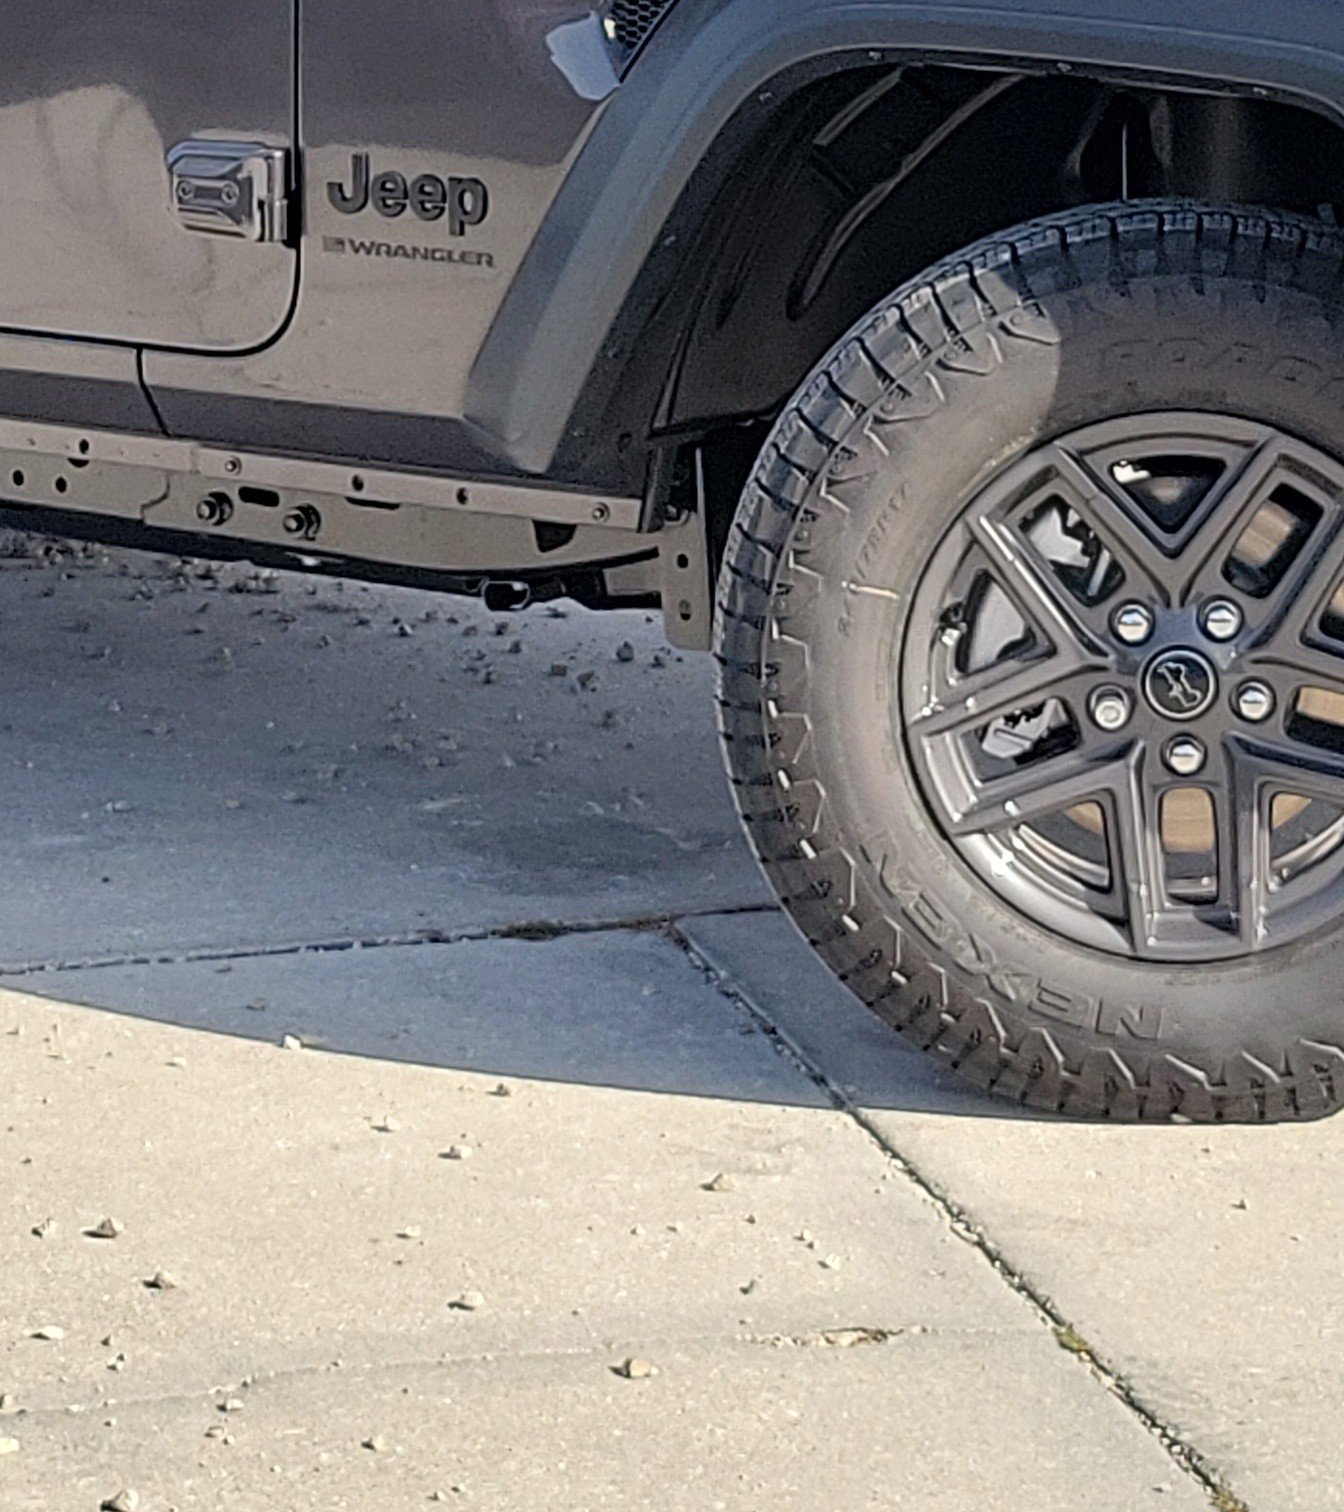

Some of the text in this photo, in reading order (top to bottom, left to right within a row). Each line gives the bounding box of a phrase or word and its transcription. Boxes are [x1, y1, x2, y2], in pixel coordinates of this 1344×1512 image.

[326, 153, 489, 237] Jeep
[349, 238, 495, 268] WRANGLER
[858, 842, 1164, 1041] NEXEN
